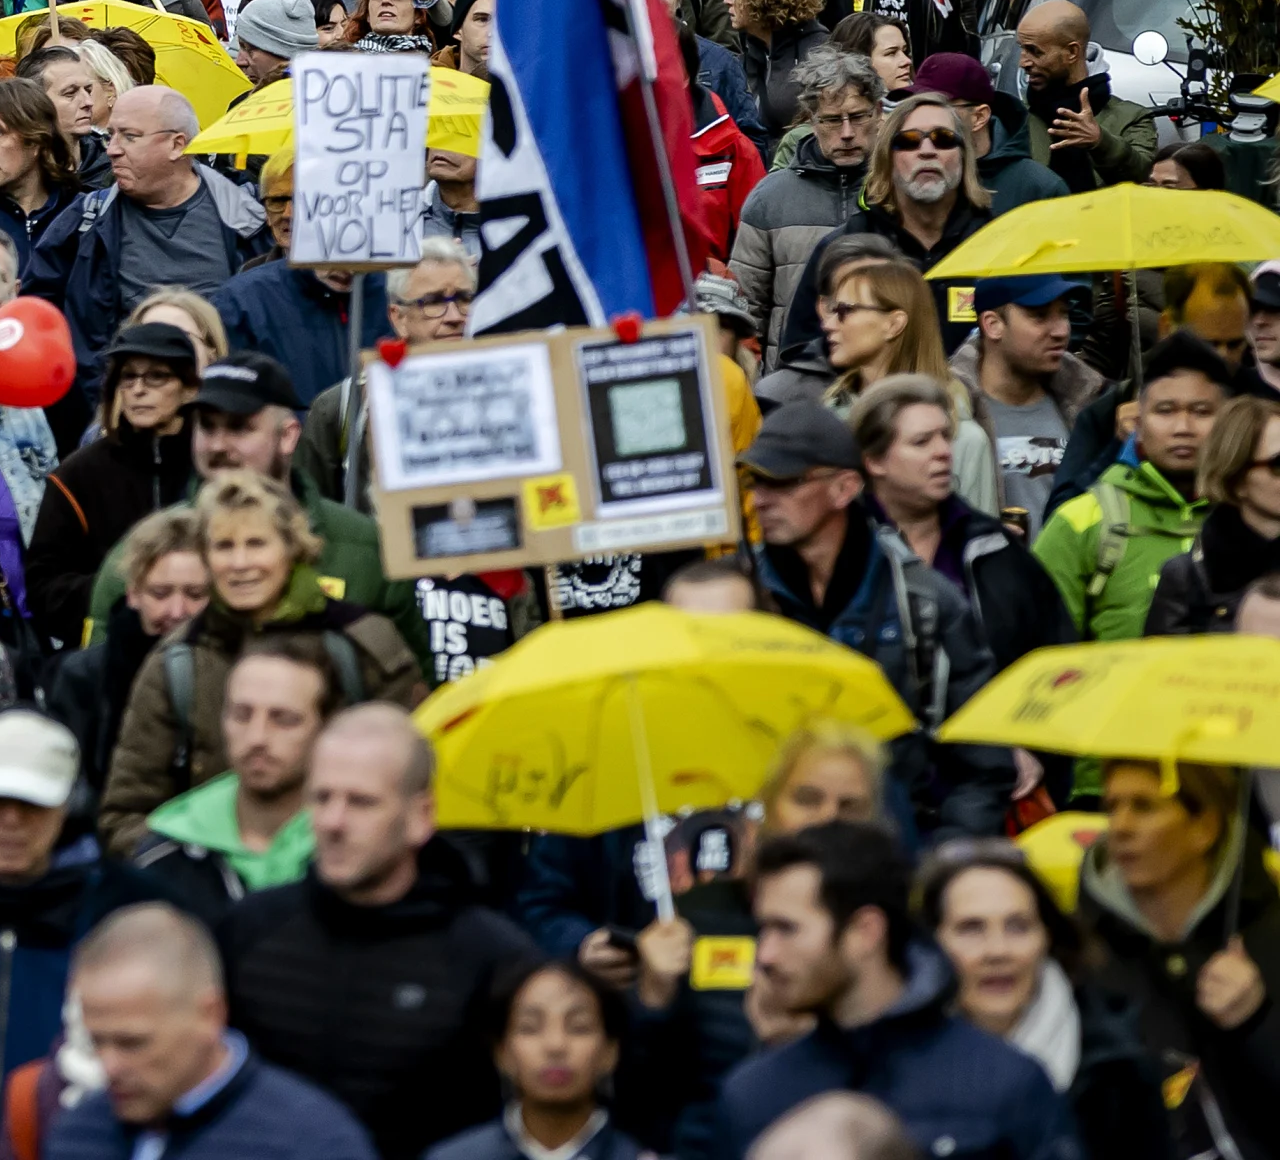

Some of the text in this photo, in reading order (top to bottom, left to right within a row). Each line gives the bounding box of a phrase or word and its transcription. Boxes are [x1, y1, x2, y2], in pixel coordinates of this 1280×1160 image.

[303, 68, 428, 126] POLITIE
[325, 111, 409, 153] STA
[336, 160, 389, 197] OP
[302, 186, 421, 221] VOOR HET
[316, 210, 425, 260] VOLK
[430, 620, 468, 654] IS
